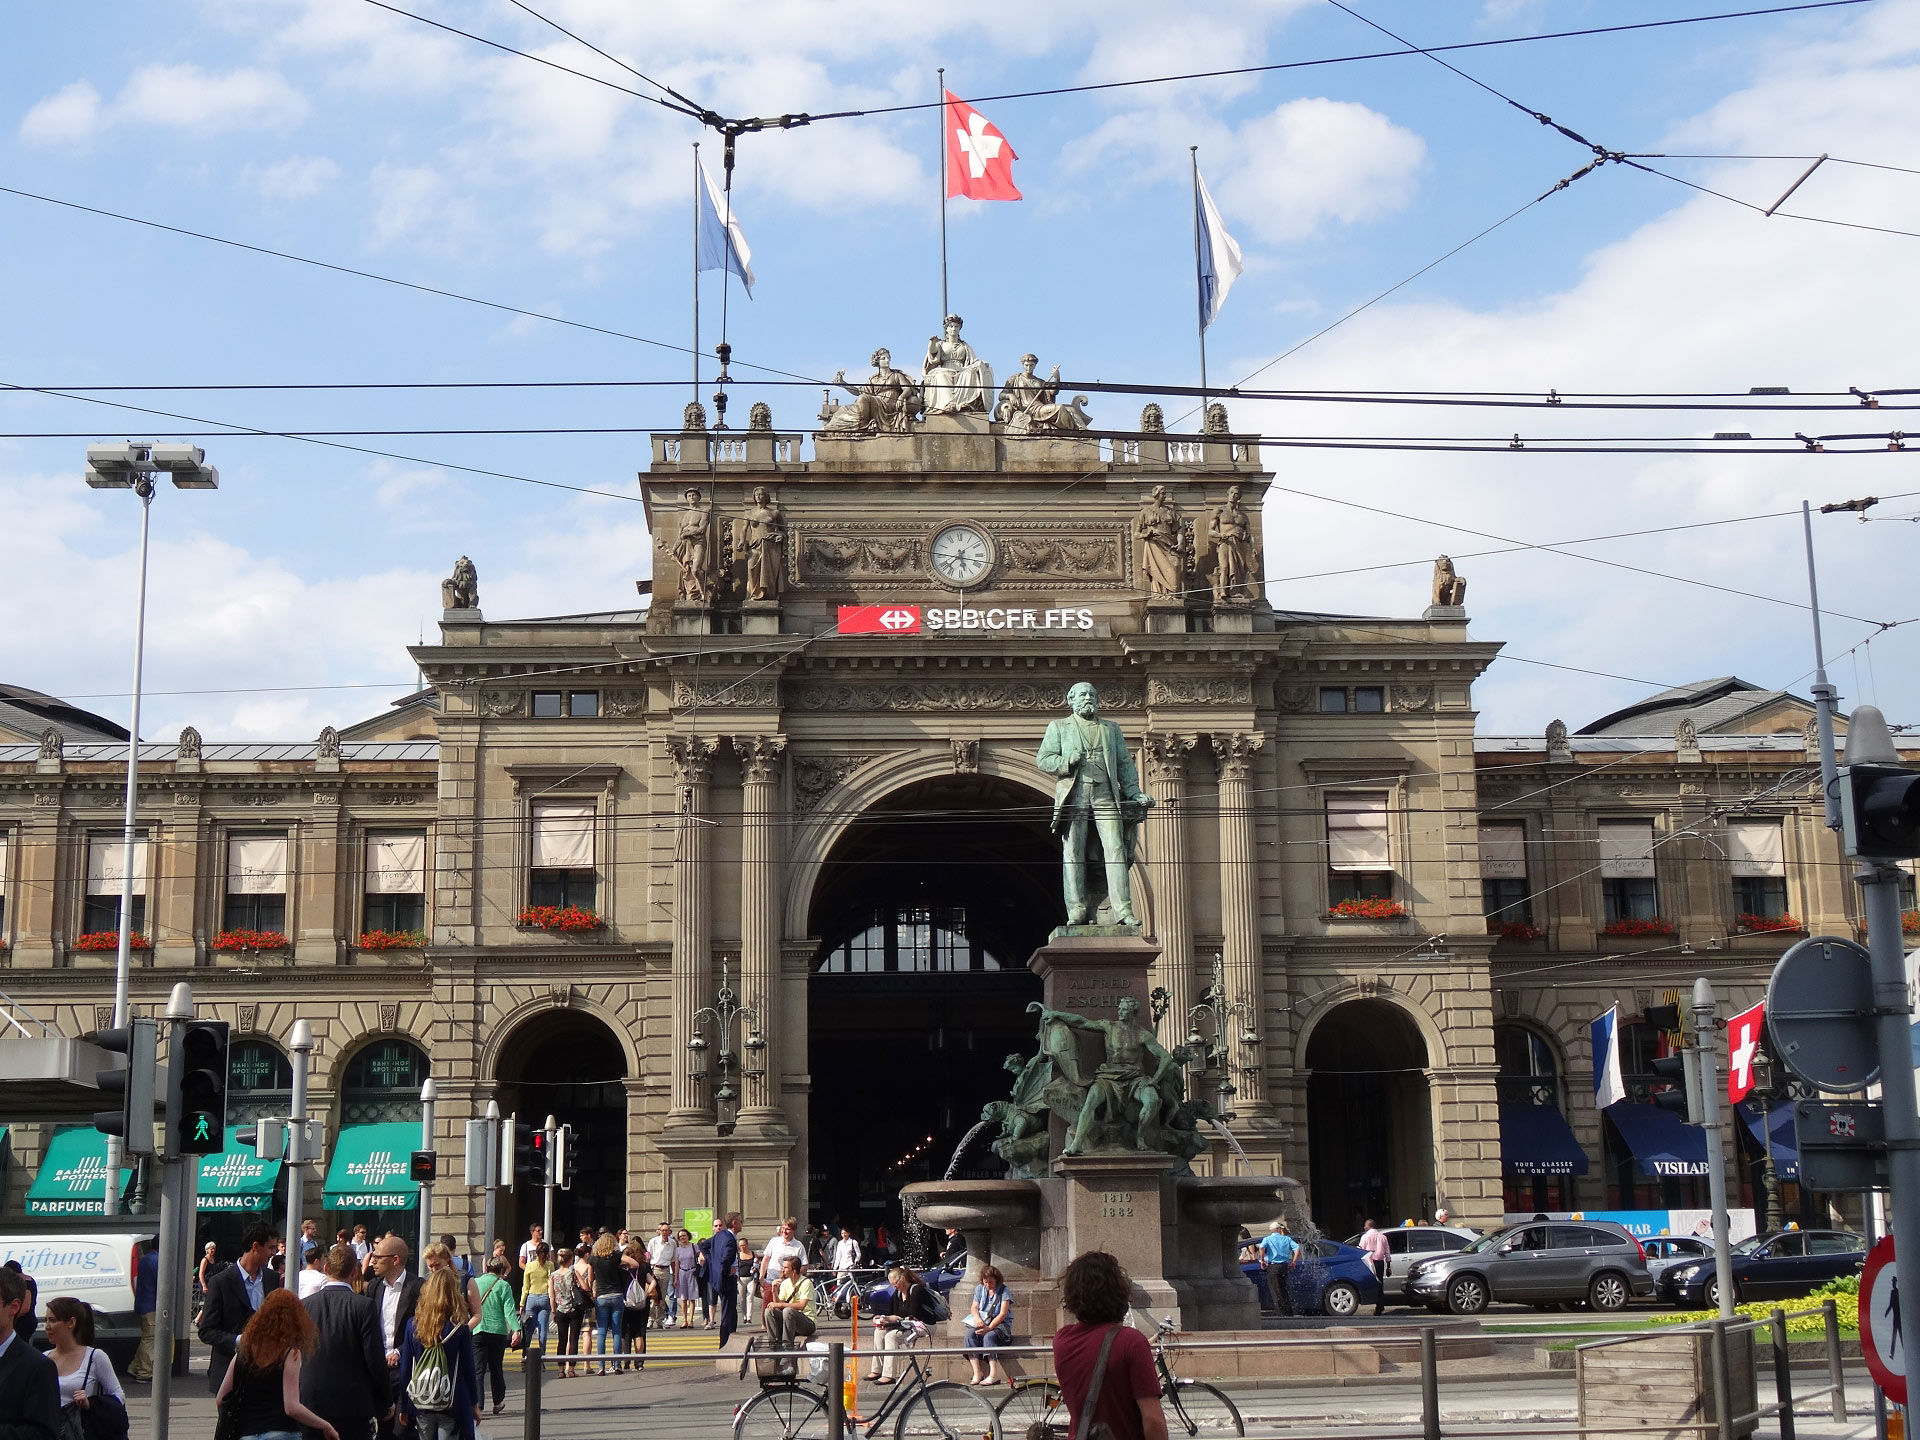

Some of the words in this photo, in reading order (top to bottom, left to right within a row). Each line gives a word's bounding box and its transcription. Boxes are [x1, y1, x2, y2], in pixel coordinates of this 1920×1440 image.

[926, 608, 980, 630] SBB
[1045, 608, 1094, 630] FFS
[1069, 979, 1131, 989] ALFRED
[1065, 995, 1134, 1009] ESCHE
[55, 1168, 107, 1176] BAHNHO
[203, 1164, 263, 1172] BAHNHOF
[1653, 1161, 1710, 1175] VISILAB
[53, 1173, 108, 1182] APOTHEK
[196, 1196, 261, 1208] HARMACY
[336, 1195, 405, 1206] APOTHEKE
[1103, 1193, 1132, 1203] 1819
[31, 1201, 107, 1212] PARFUMERI
[1103, 1207, 1134, 1218] 1882
[4, 1247, 101, 1273] Lüftung
[63, 1276, 122, 1287] Reinigung
